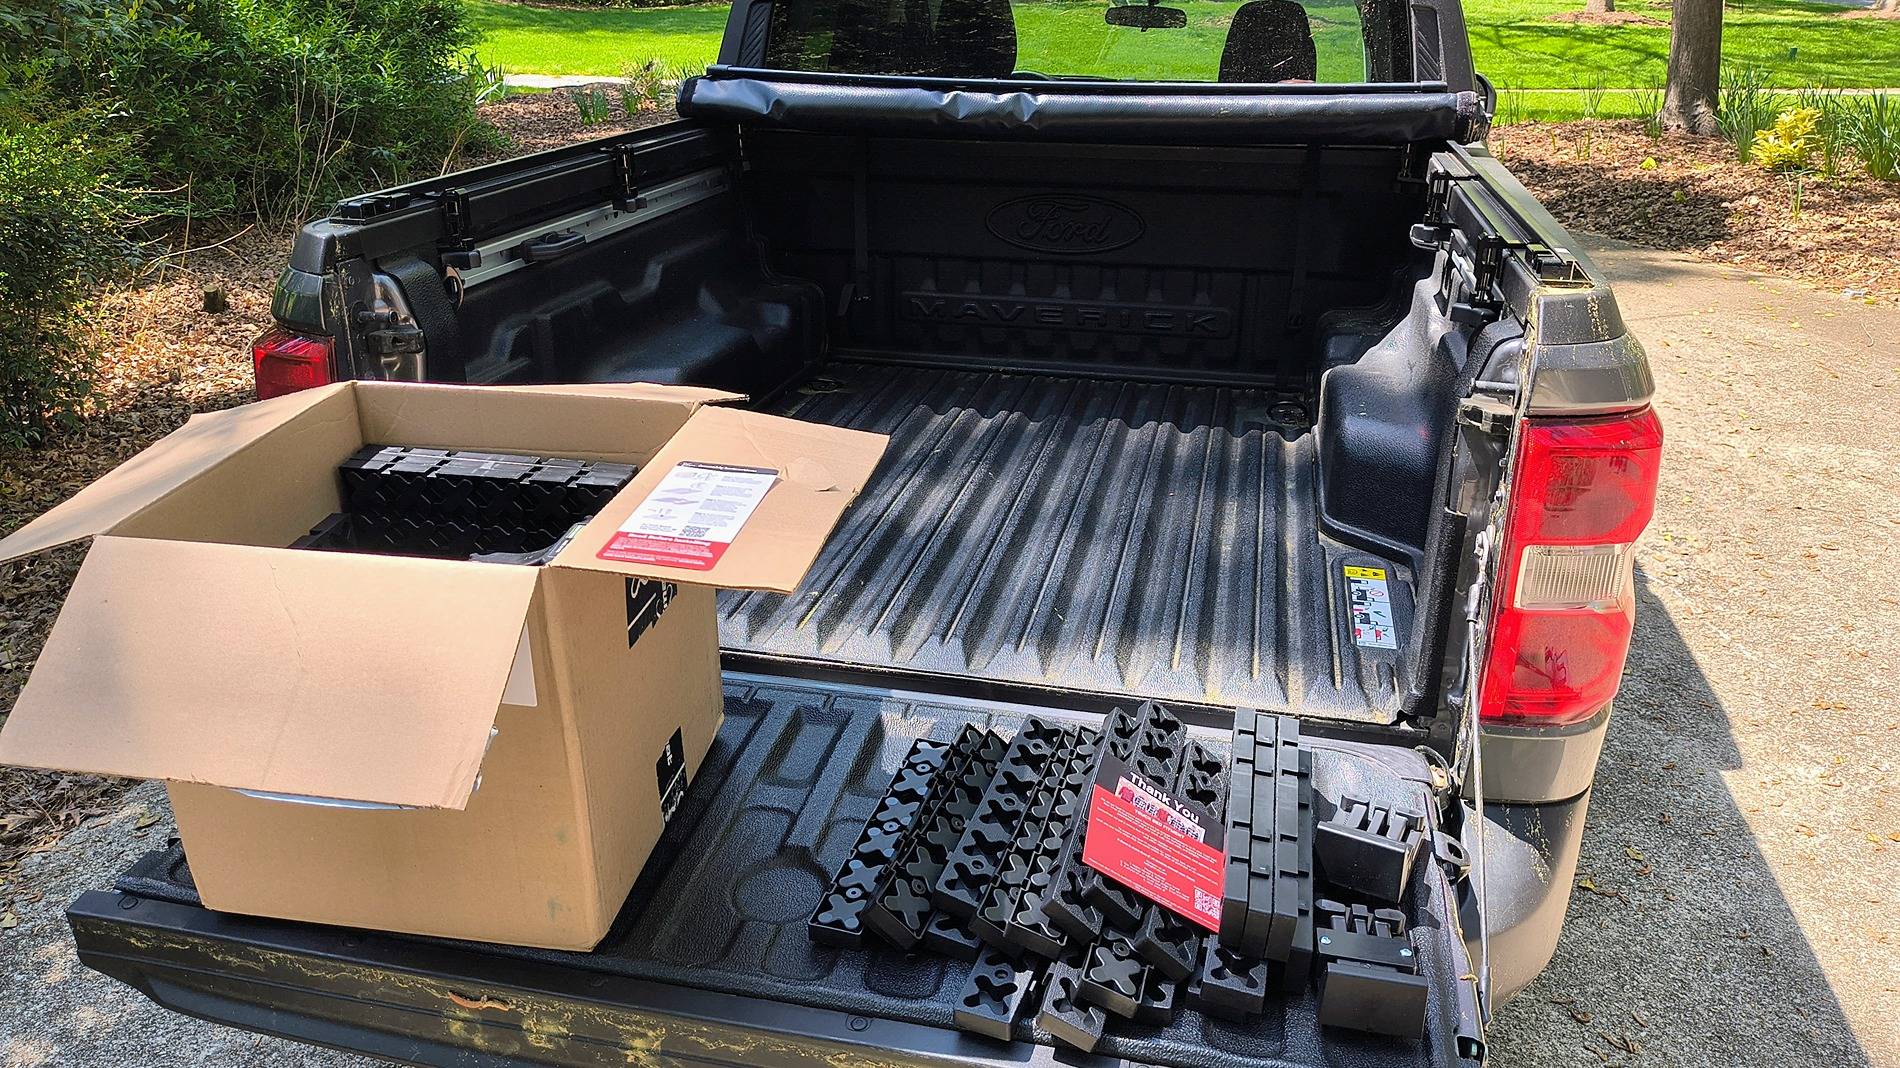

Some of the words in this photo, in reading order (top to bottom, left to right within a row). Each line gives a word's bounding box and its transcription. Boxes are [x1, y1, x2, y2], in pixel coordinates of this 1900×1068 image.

[1016, 200, 1113, 244] Ford
[906, 296, 1219, 332] MAVERICK
[1130, 771, 1172, 806] Thank
[1173, 799, 1200, 824] You
